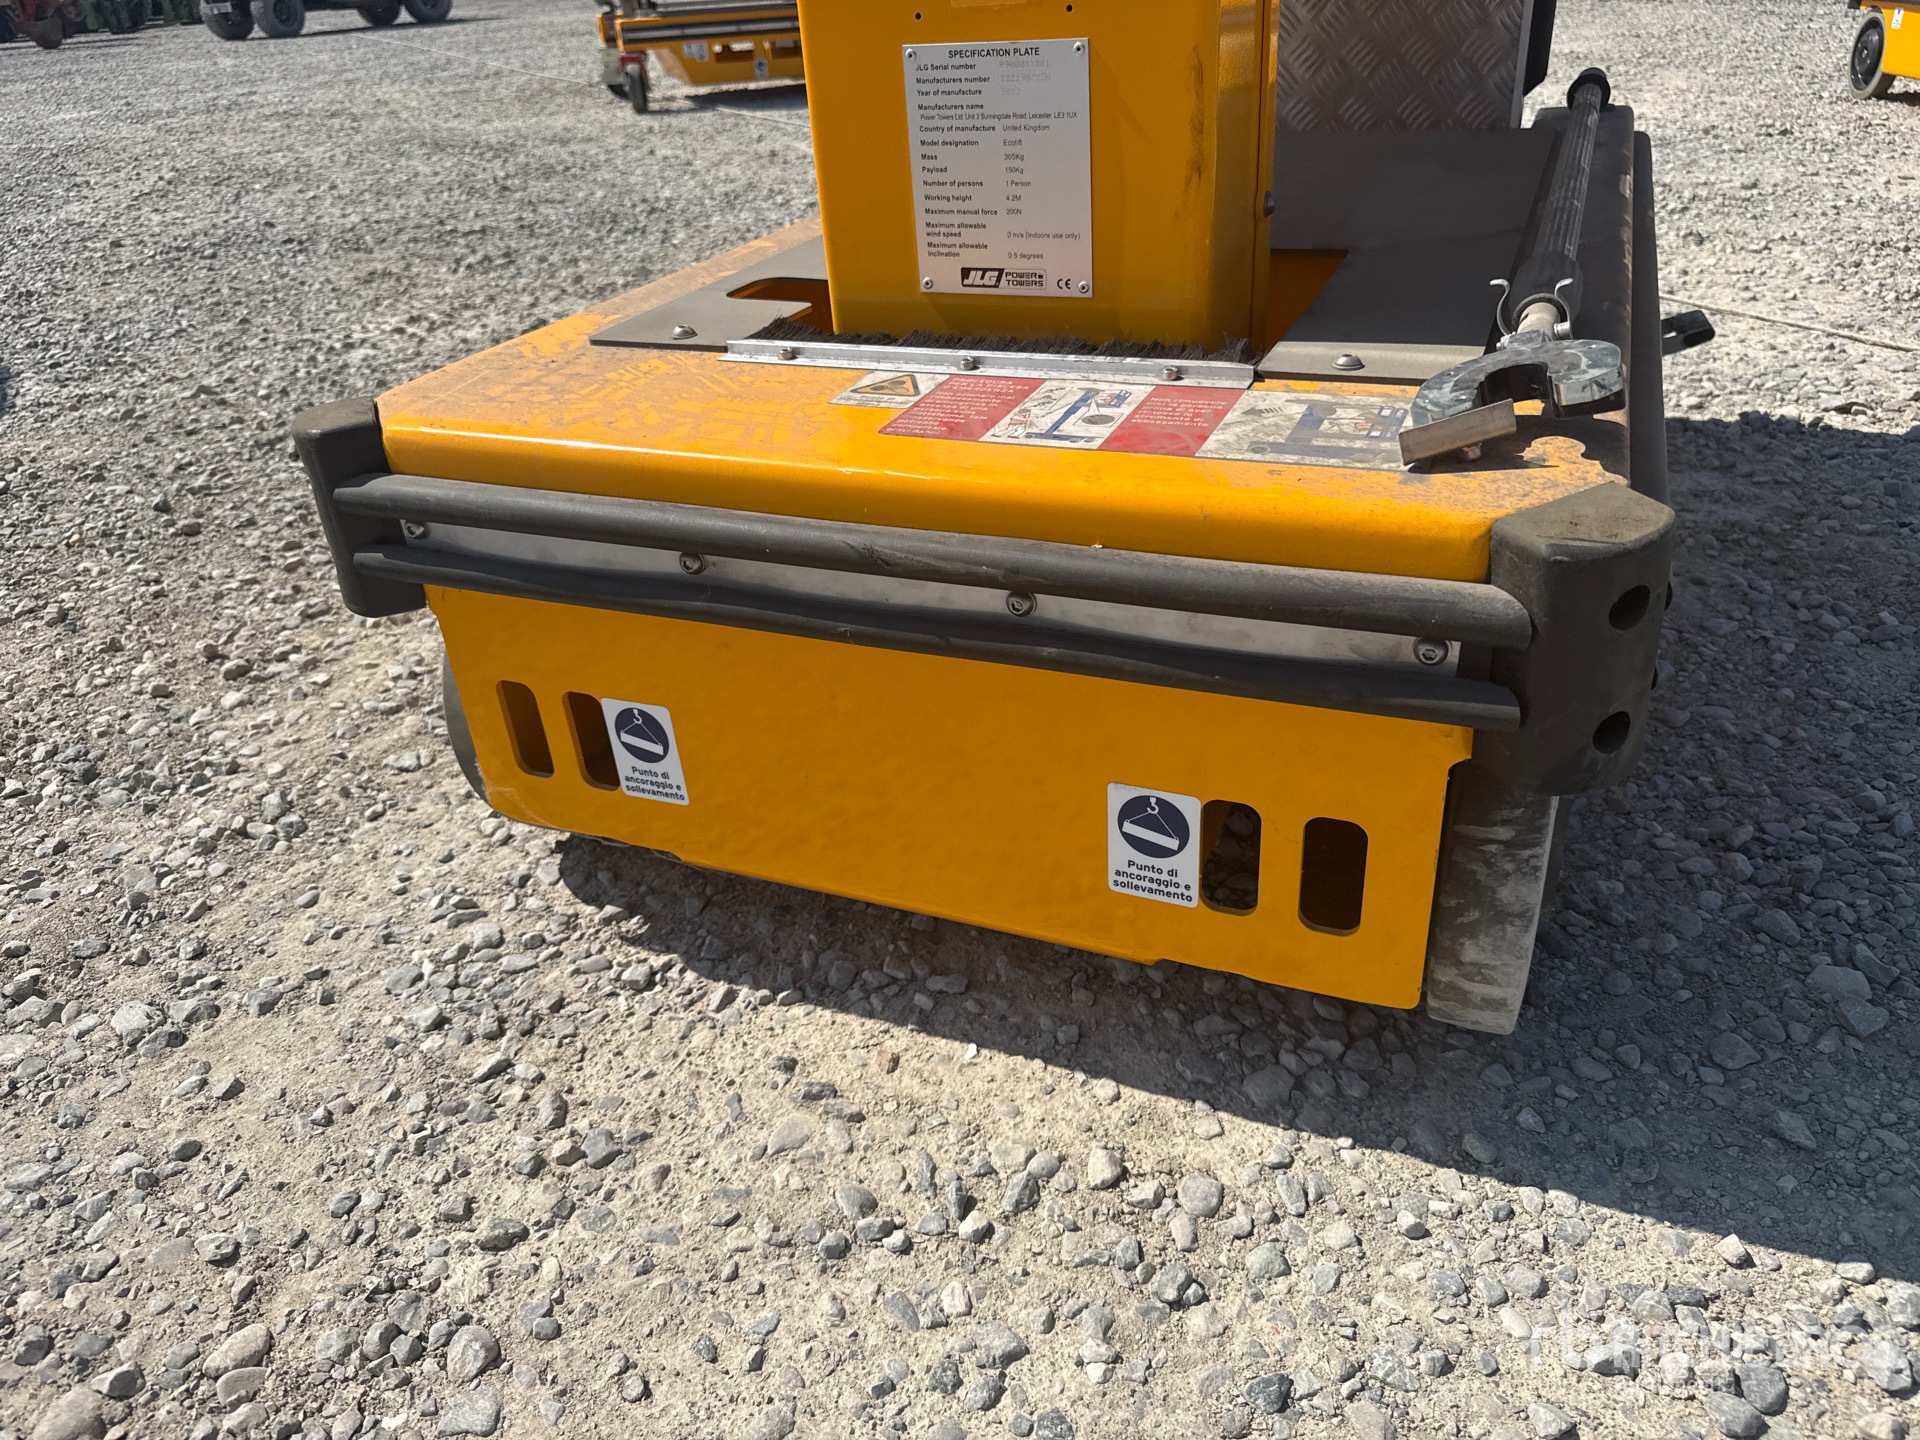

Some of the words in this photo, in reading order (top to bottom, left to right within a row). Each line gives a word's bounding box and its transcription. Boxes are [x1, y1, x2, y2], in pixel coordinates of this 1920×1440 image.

[948, 48, 1011, 59] SPECIFICATION
[1013, 47, 1040, 57] PLATE
[930, 63, 950, 71] Serial
[915, 76, 963, 84] Manufacturers
[916, 89, 931, 97] Year
[940, 88, 982, 96] manufacture
[917, 103, 964, 111] Manufacturers
[937, 113, 954, 121] Towers
[980, 112, 1011, 121] Sunningdale
[1053, 111, 1065, 119] LE3
[1066, 111, 1078, 119] 1UX
[919, 125, 945, 133] Country
[954, 124, 996, 132] manufacture
[1002, 124, 1022, 132] United
[1023, 124, 1050, 133] Kingdom
[920, 139, 940, 147] Model
[940, 139, 979, 148] designation
[1003, 153, 1025, 161] 305Kg
[921, 166, 948, 174] Payload
[1005, 166, 1024, 174] 150Kg
[924, 194, 951, 202] Working
[951, 194, 972, 203] height
[925, 221, 956, 229] Maximum
[1025, 231, 1050, 240] (indoors
[1064, 232, 1081, 240] only)
[927, 241, 957, 249] Maximum
[1019, 252, 1044, 261] degrees
[963, 270, 999, 286] JLG
[1005, 271, 1038, 279] POWER
[1005, 279, 1044, 287] TOWERS
[631, 766, 659, 778] Punto
[660, 771, 670, 780] di
[624, 775, 674, 790] ancoraggio
[675, 783, 682, 791] e
[625, 784, 685, 801] sollevamento
[1127, 859, 1163, 875] Punto
[1167, 868, 1178, 878] di
[1114, 869, 1180, 889] ancoraggio
[1184, 883, 1191, 891] e
[1113, 879, 1193, 902] sollevamento
